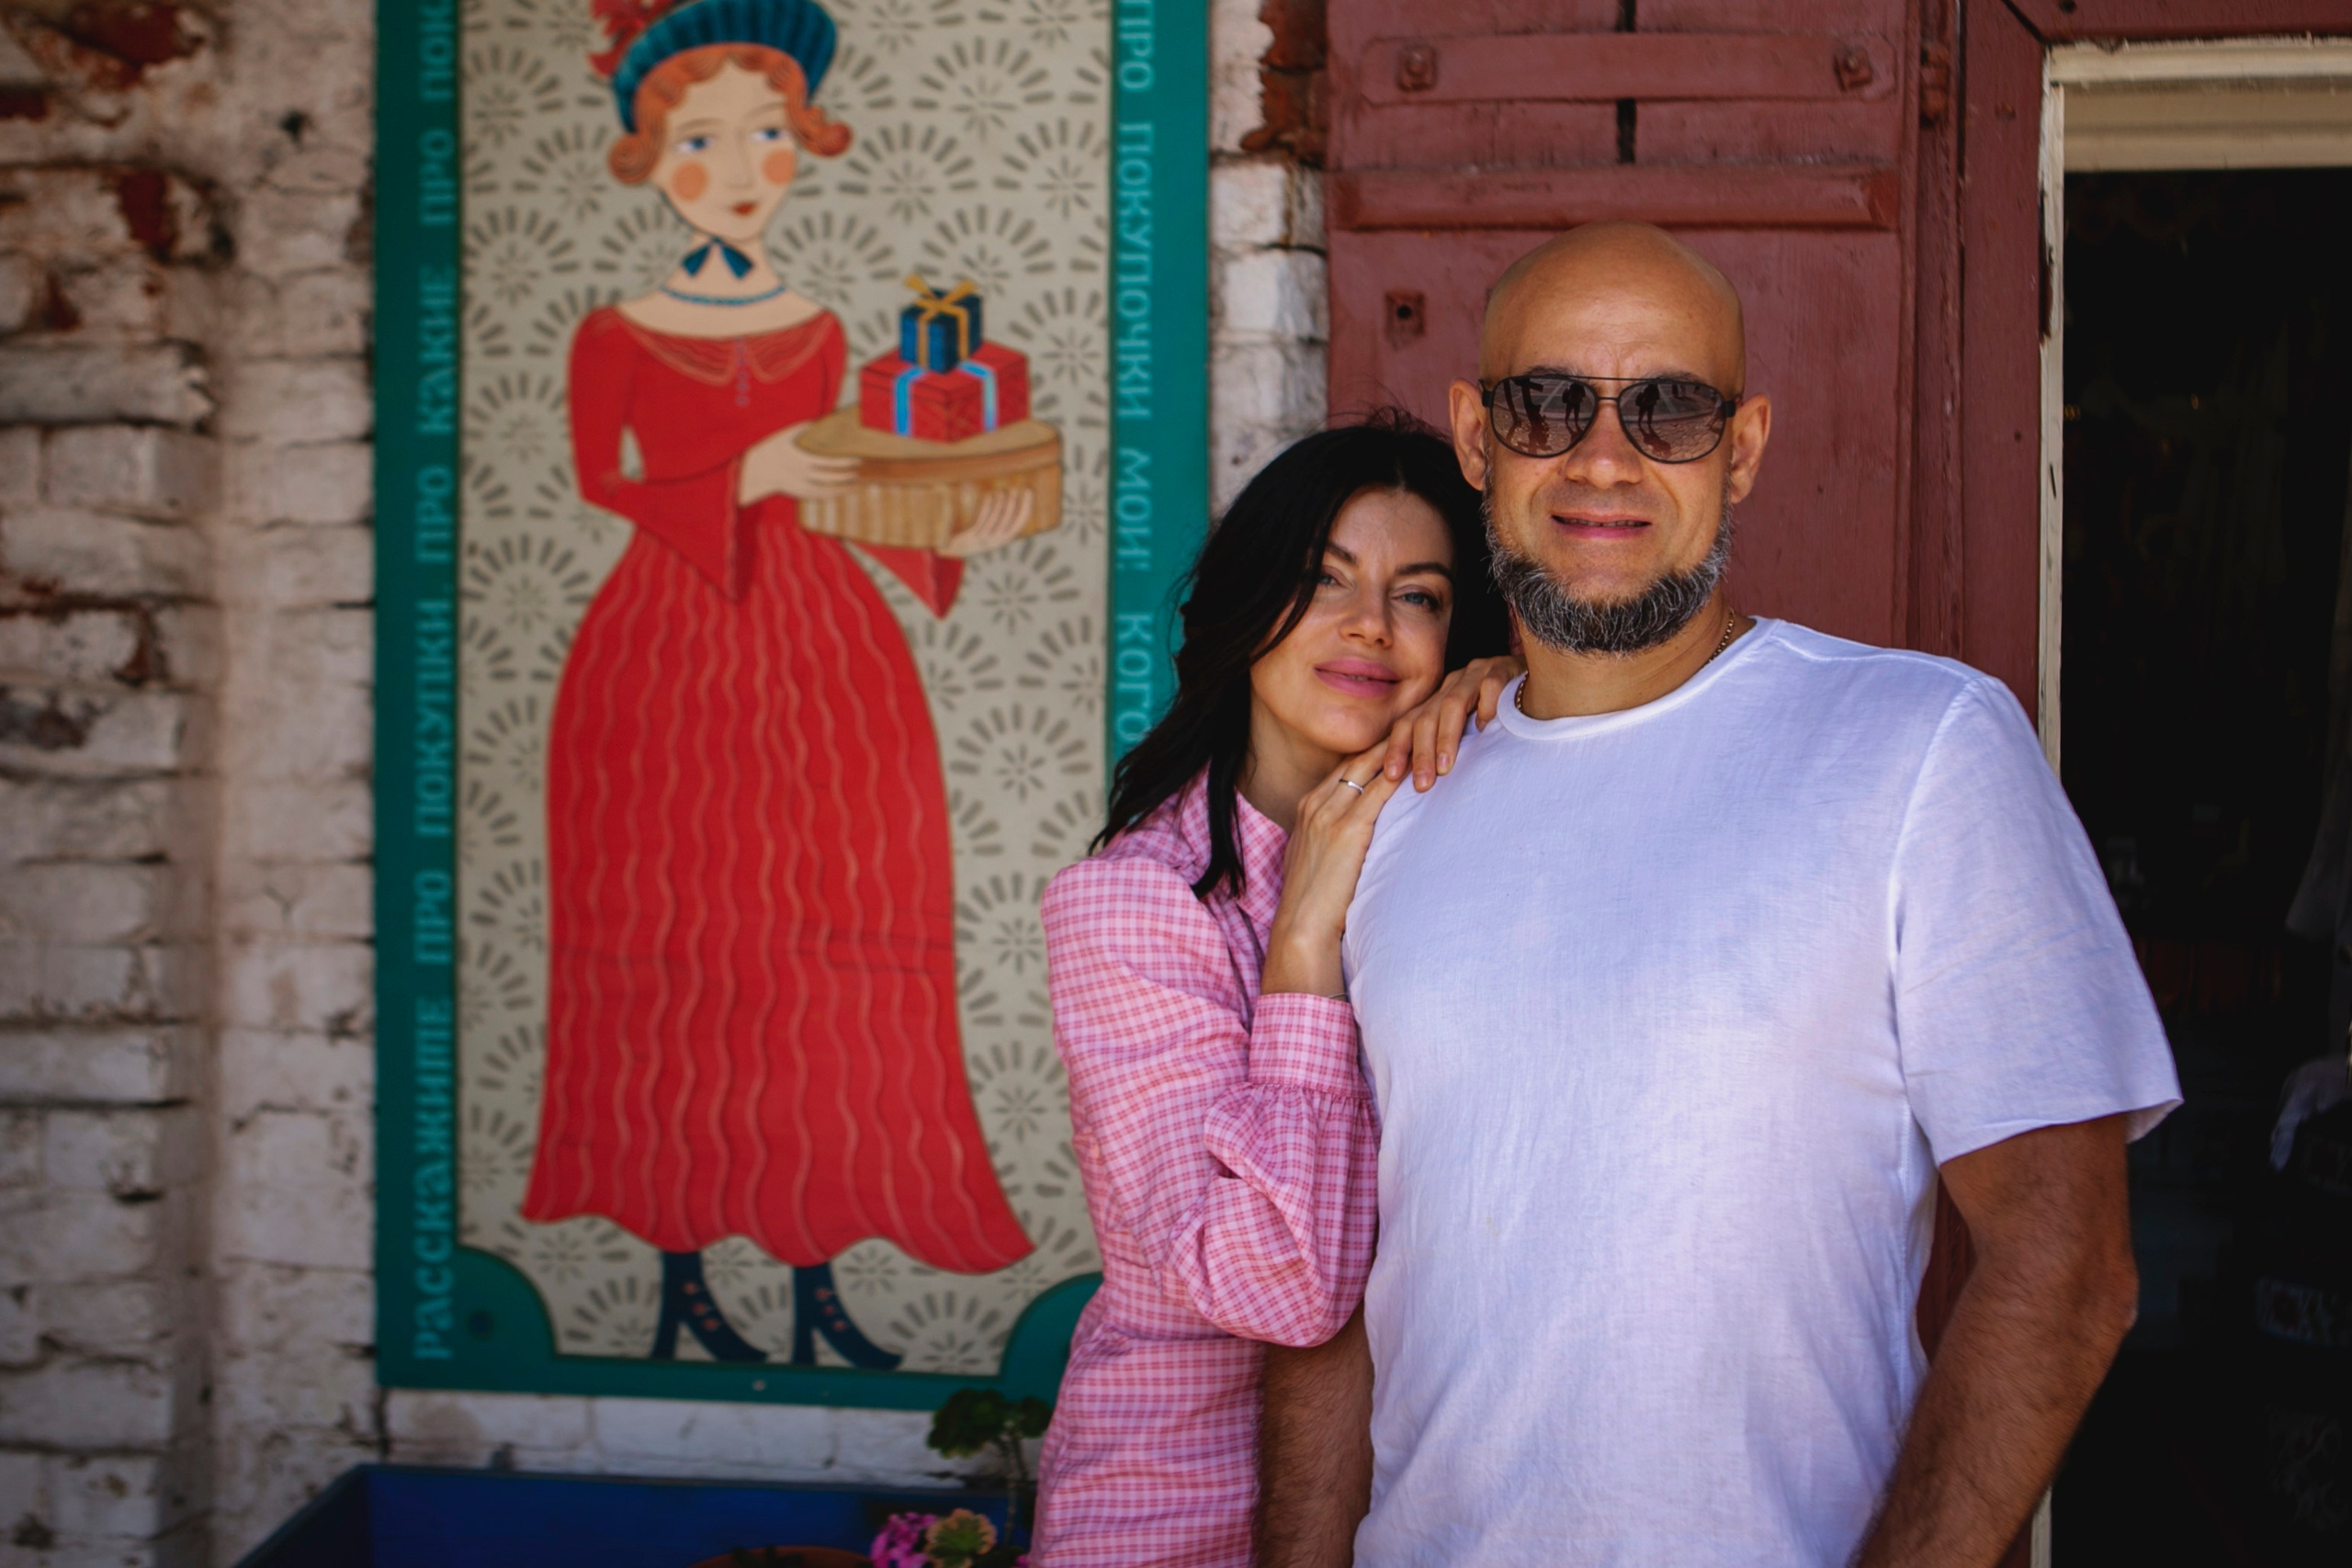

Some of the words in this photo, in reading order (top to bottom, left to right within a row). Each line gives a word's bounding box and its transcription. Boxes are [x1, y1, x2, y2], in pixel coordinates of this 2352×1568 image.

[1118, 0, 1154, 92] ПРО
[418, 128, 456, 226] ПРО
[1117, 121, 1154, 420] ПОКУПОЧКИ
[415, 264, 455, 434] КАКИЕ
[415, 465, 453, 563] ПРО
[413, 870, 452, 964] ПРО
[413, 997, 453, 1359] РАССКАЖИТЕ
